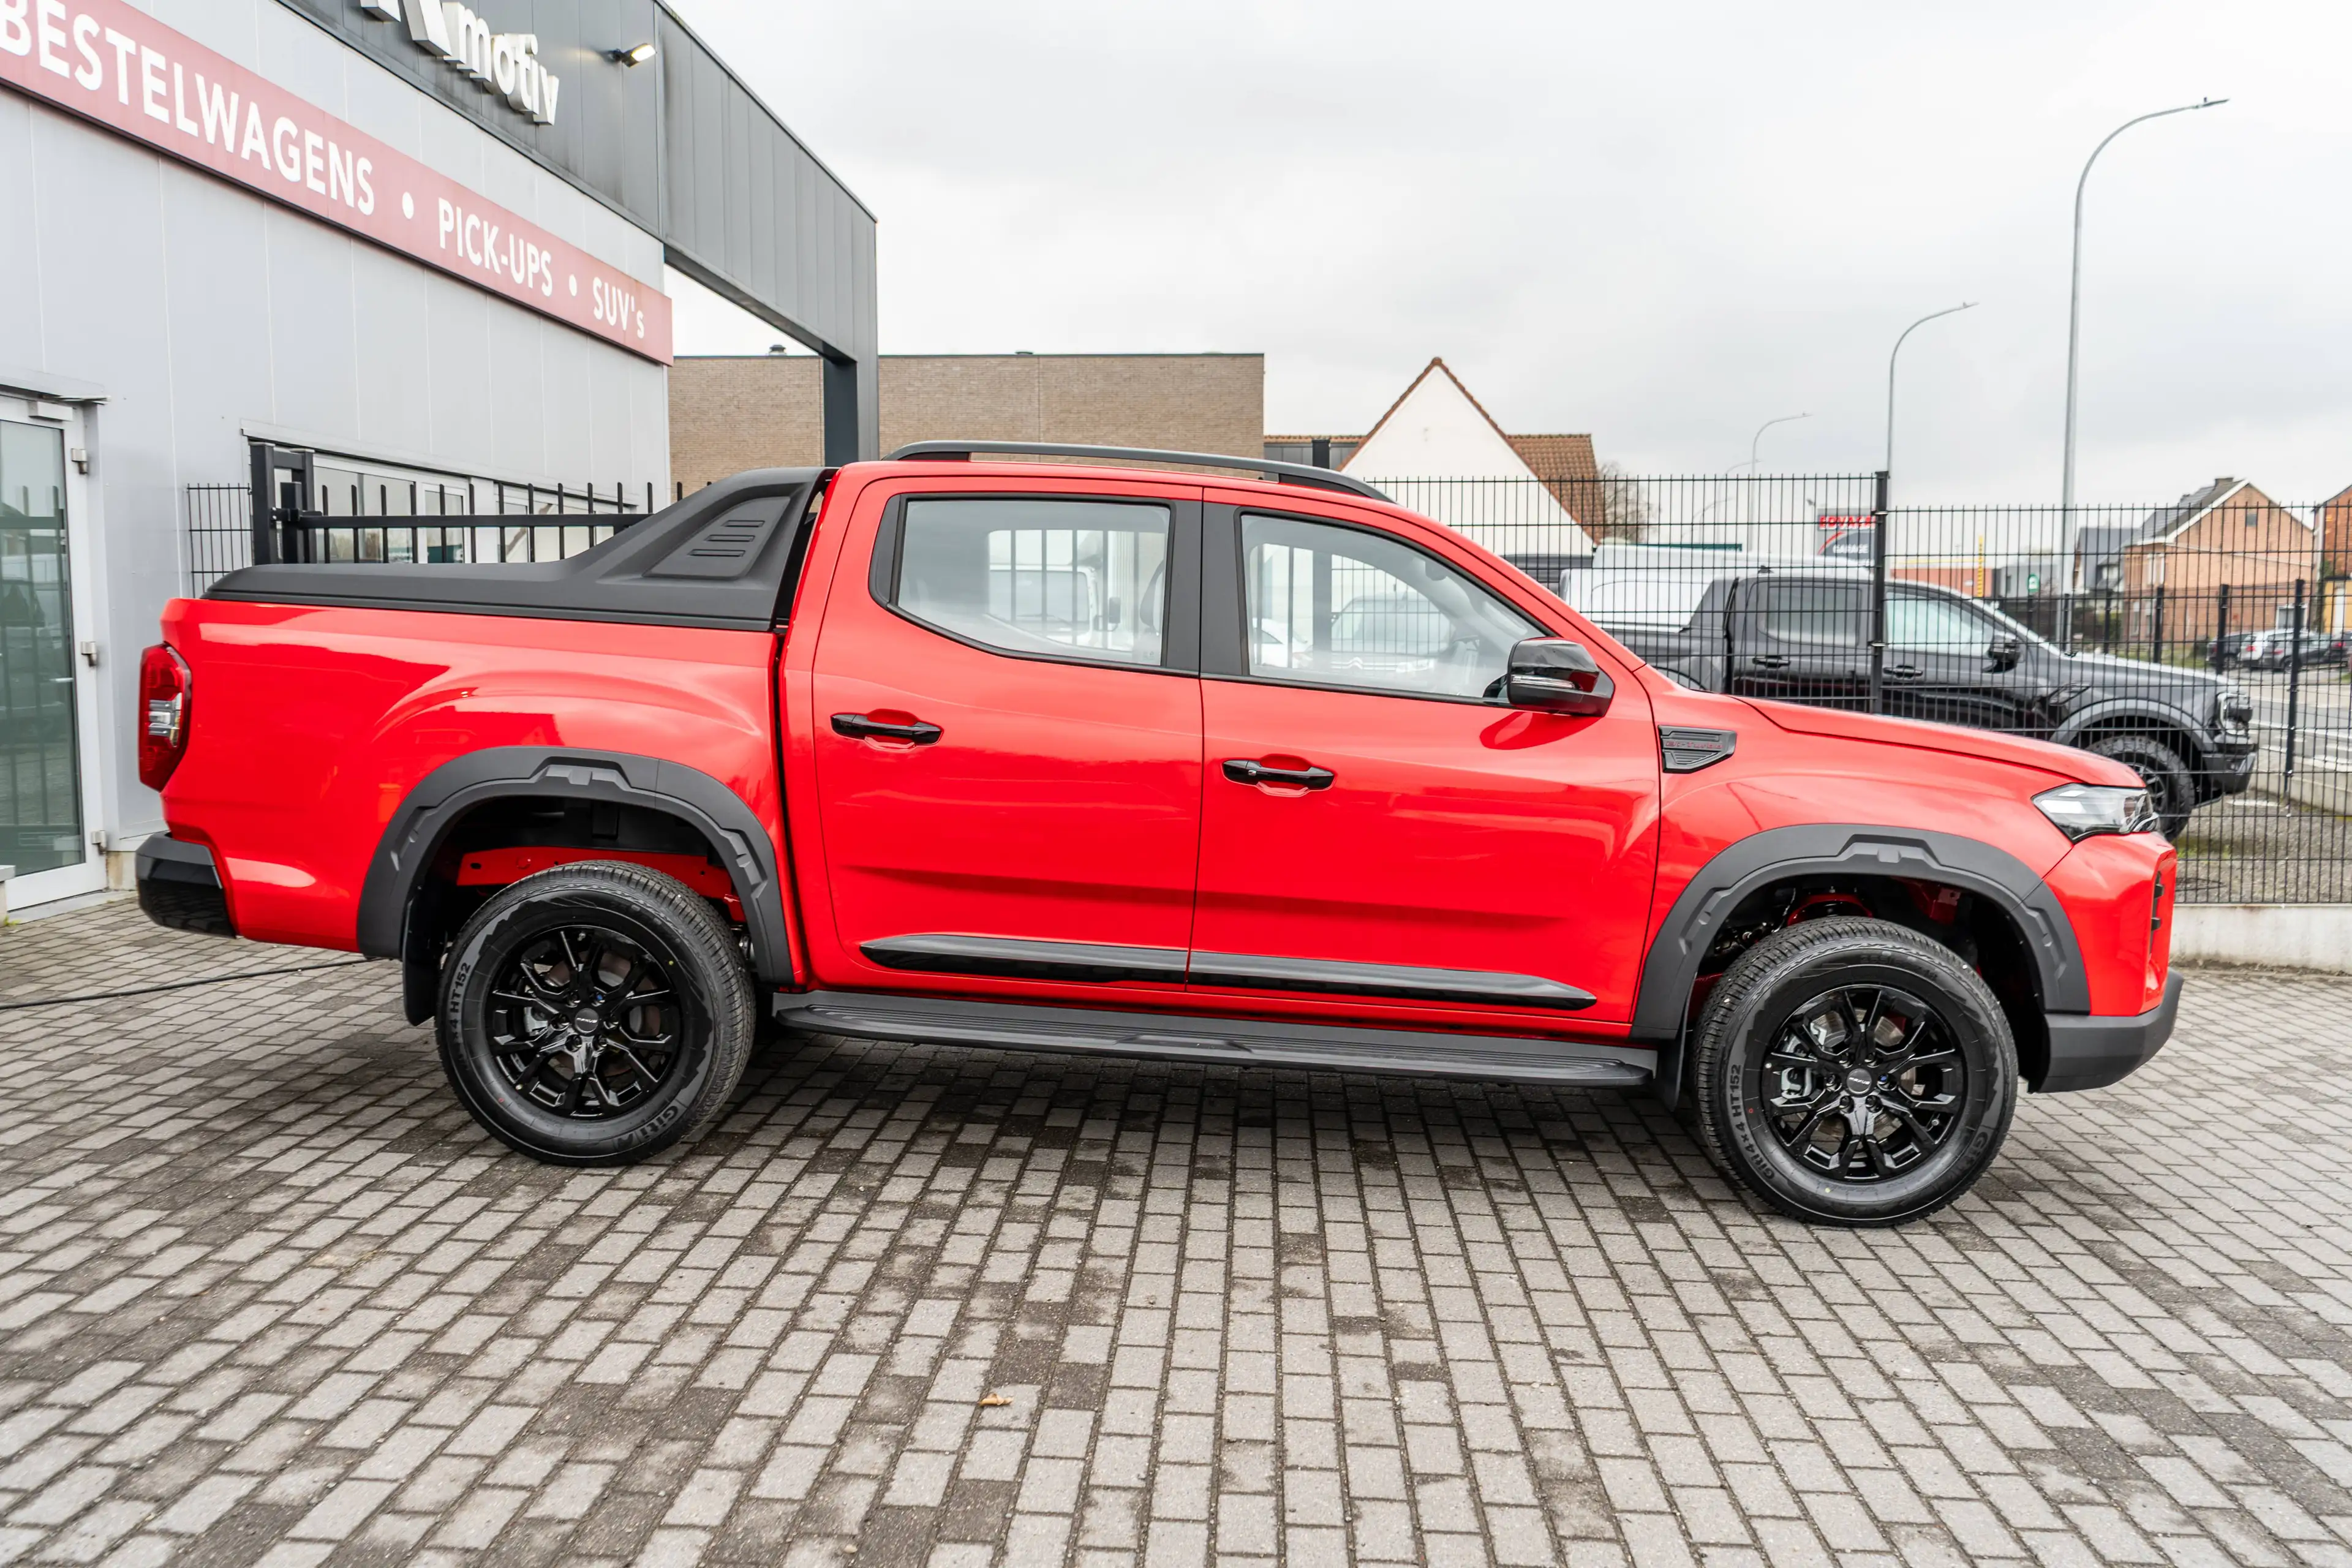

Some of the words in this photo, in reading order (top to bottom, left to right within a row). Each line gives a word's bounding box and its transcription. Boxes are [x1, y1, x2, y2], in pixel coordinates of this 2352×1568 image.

[0, 0, 375, 216] BESTELWAGENS
[438, 197, 552, 298] PICK-UPS
[592, 276, 645, 339] SUV's
[449, 962, 471, 1014] HT152
[1729, 1064, 1743, 1118] HT152
